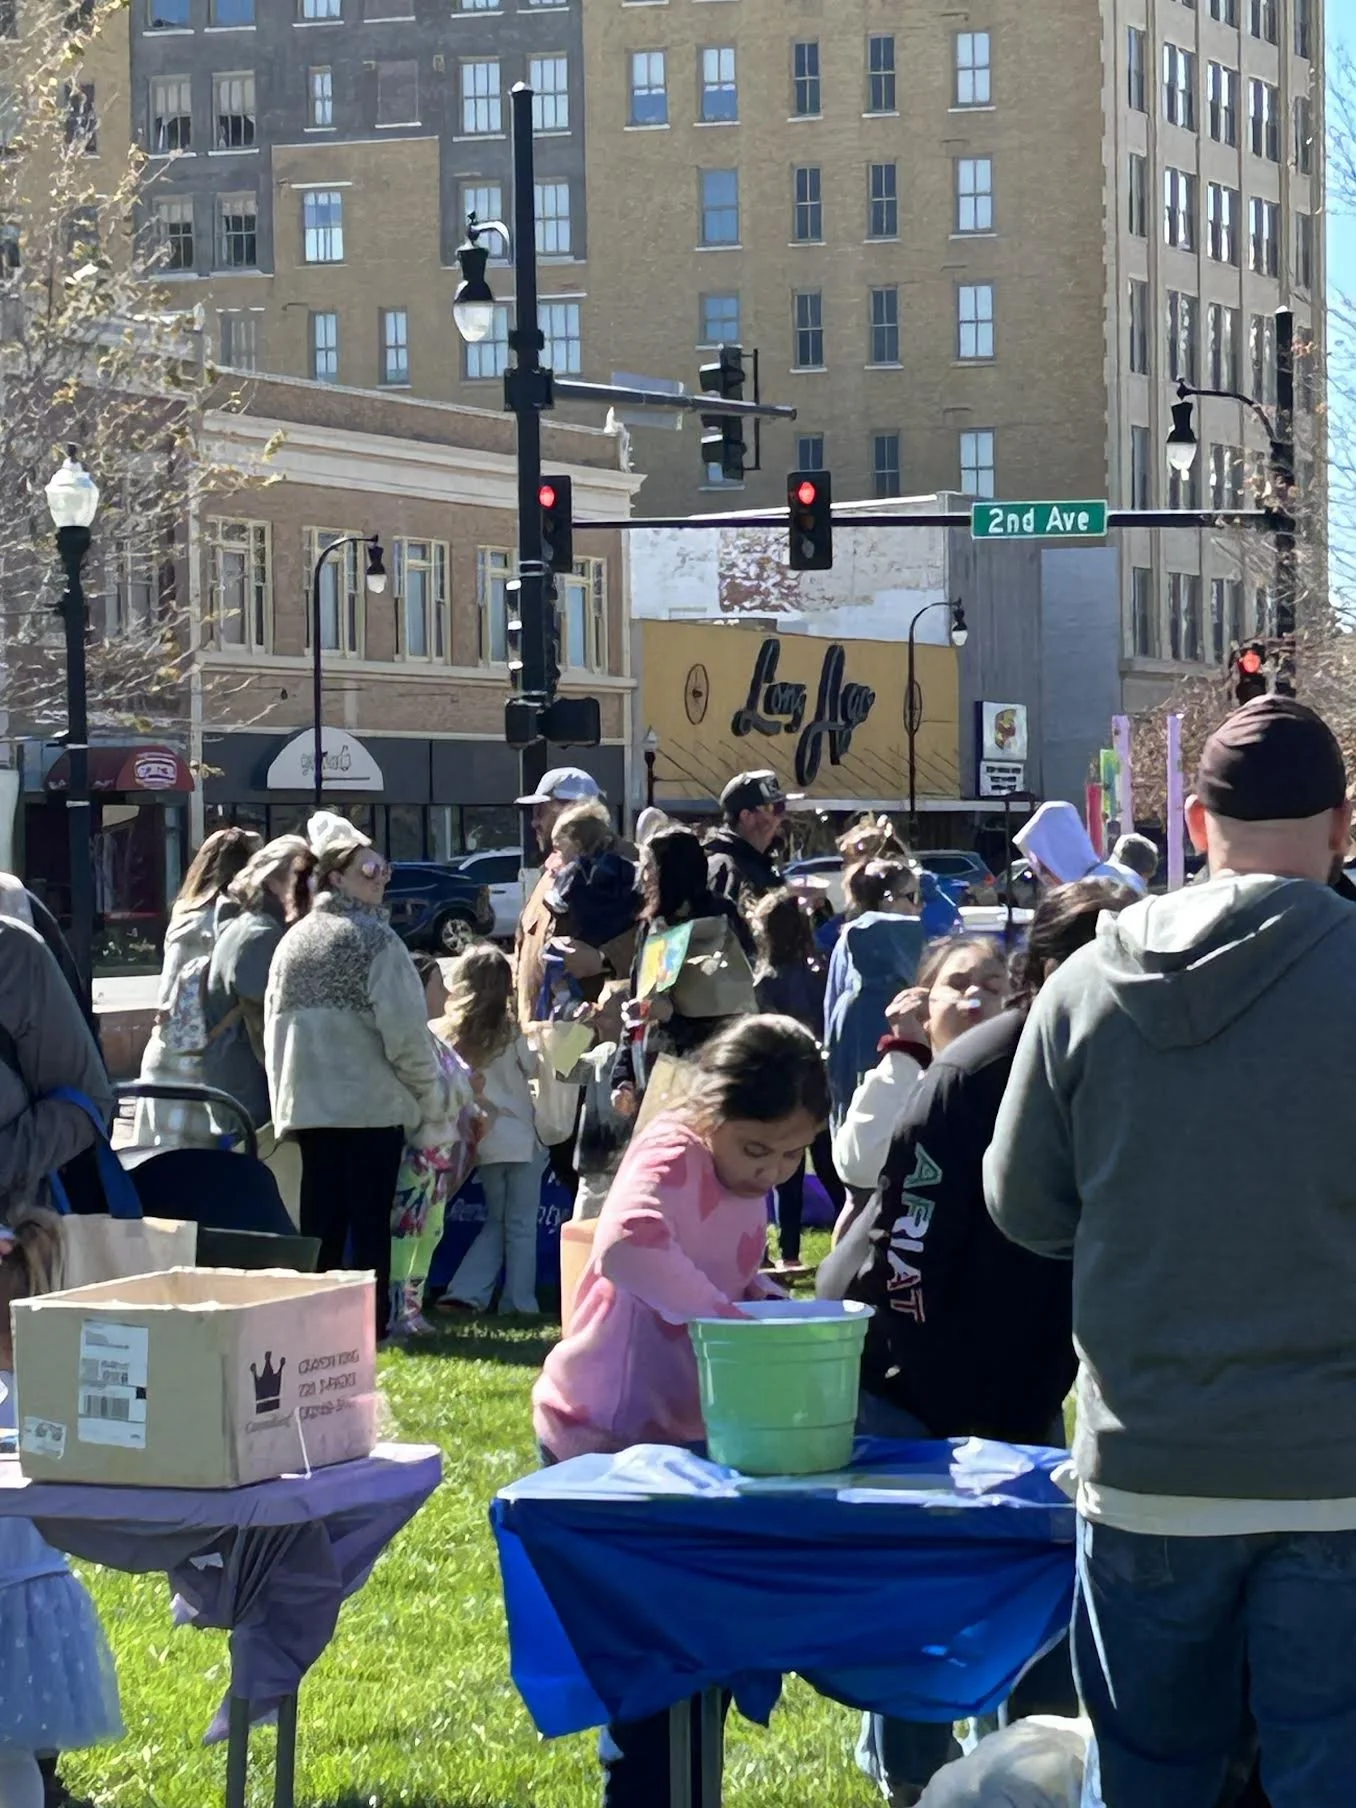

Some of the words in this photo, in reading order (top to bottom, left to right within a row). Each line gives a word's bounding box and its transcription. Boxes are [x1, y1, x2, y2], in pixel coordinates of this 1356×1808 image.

[987, 507, 1035, 534] 2nd
[1045, 505, 1090, 532] Ave
[886, 1141, 943, 1323] ARIAT
